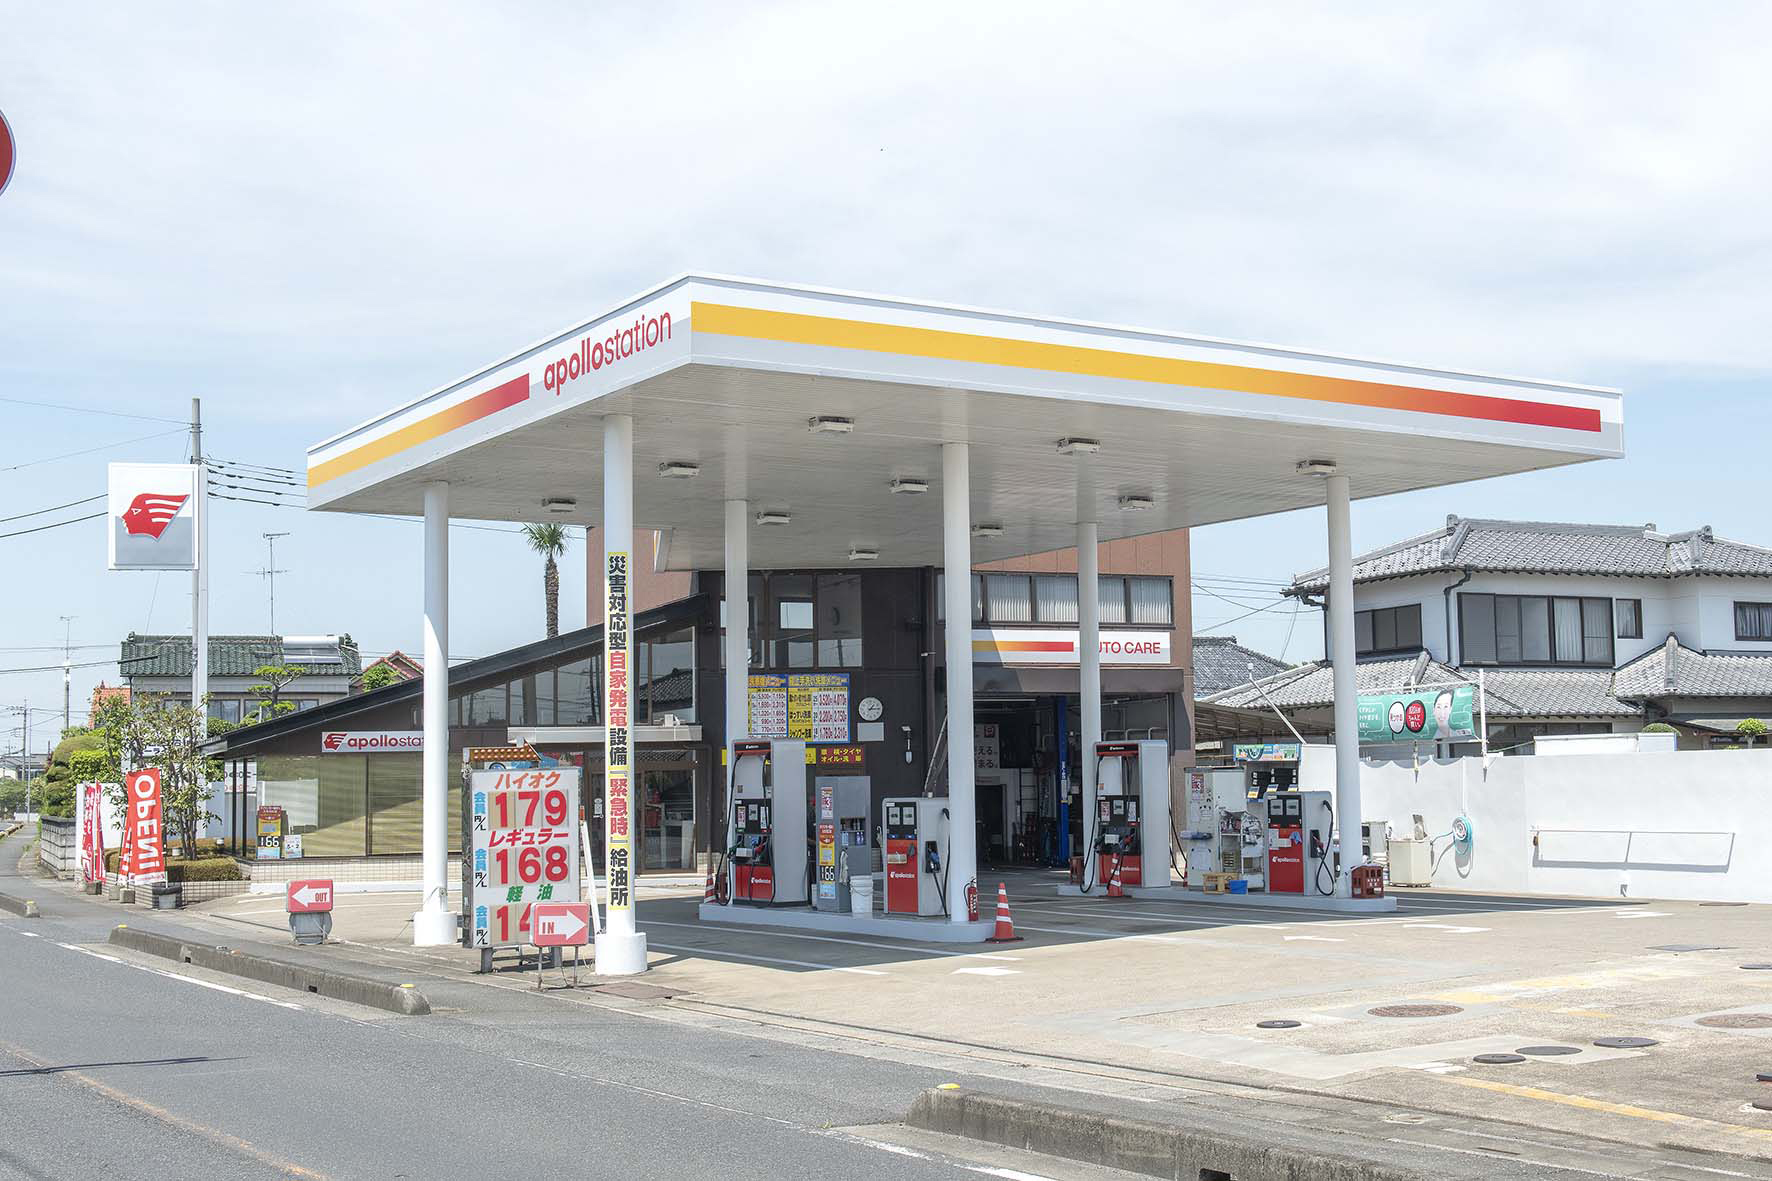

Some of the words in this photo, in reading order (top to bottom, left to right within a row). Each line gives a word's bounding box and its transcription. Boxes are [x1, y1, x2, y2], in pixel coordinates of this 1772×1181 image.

[544, 312, 672, 396] apollostation
[1124, 641, 1161, 654] CARE
[347, 734, 424, 750] apollosta
[495, 771, 561, 790] ハイオク
[495, 790, 567, 828] 179
[260, 836, 279, 847] 166
[488, 827, 569, 848] レギュラー
[495, 846, 569, 885] 168
[821, 866, 834, 881] 166
[315, 892, 327, 902] OUT
[542, 921, 554, 934] IN
